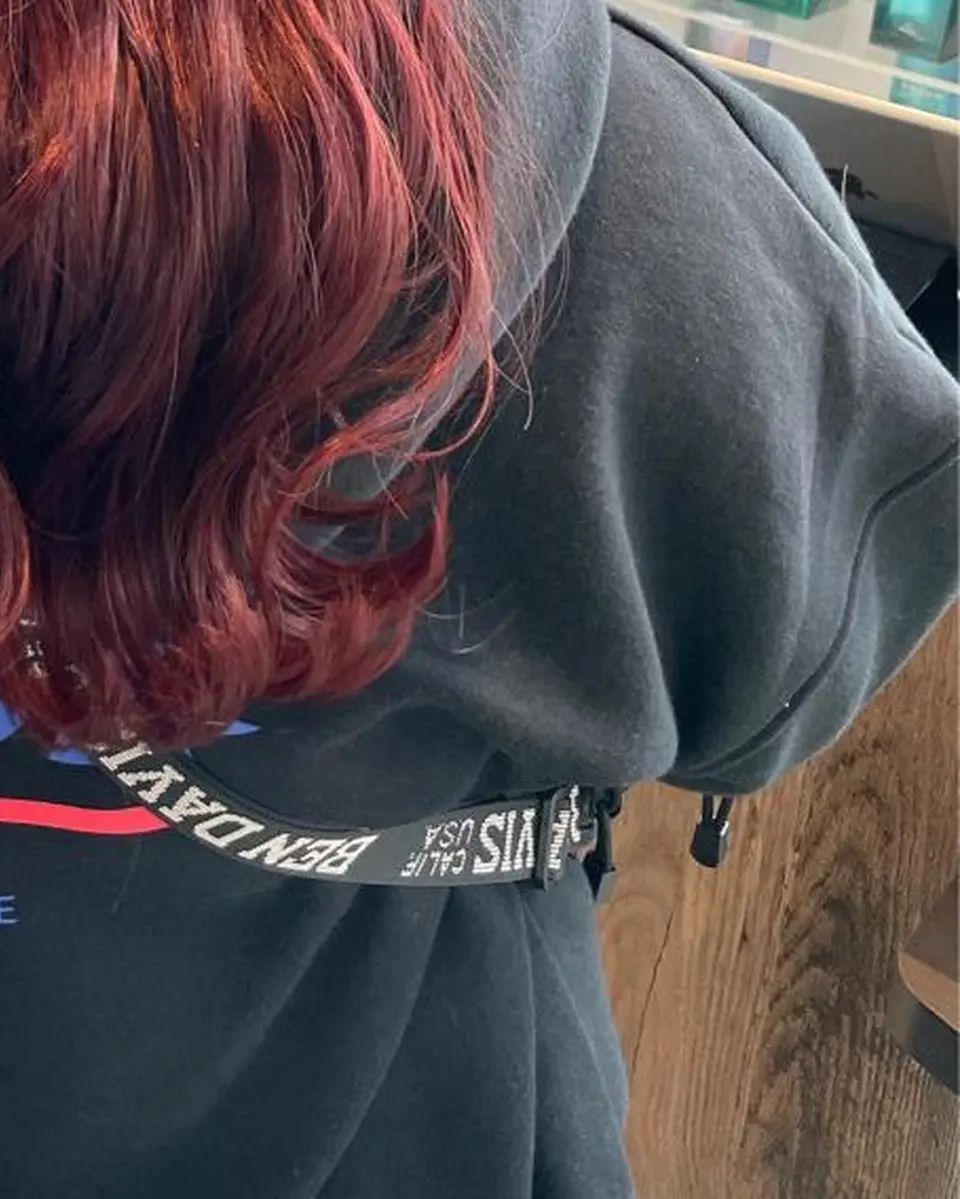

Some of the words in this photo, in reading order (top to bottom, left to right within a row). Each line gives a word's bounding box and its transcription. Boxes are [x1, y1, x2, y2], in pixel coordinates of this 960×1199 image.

[94, 734, 266, 849] DAVI
[238, 832, 380, 876] BEN
[424, 817, 475, 850] USA
